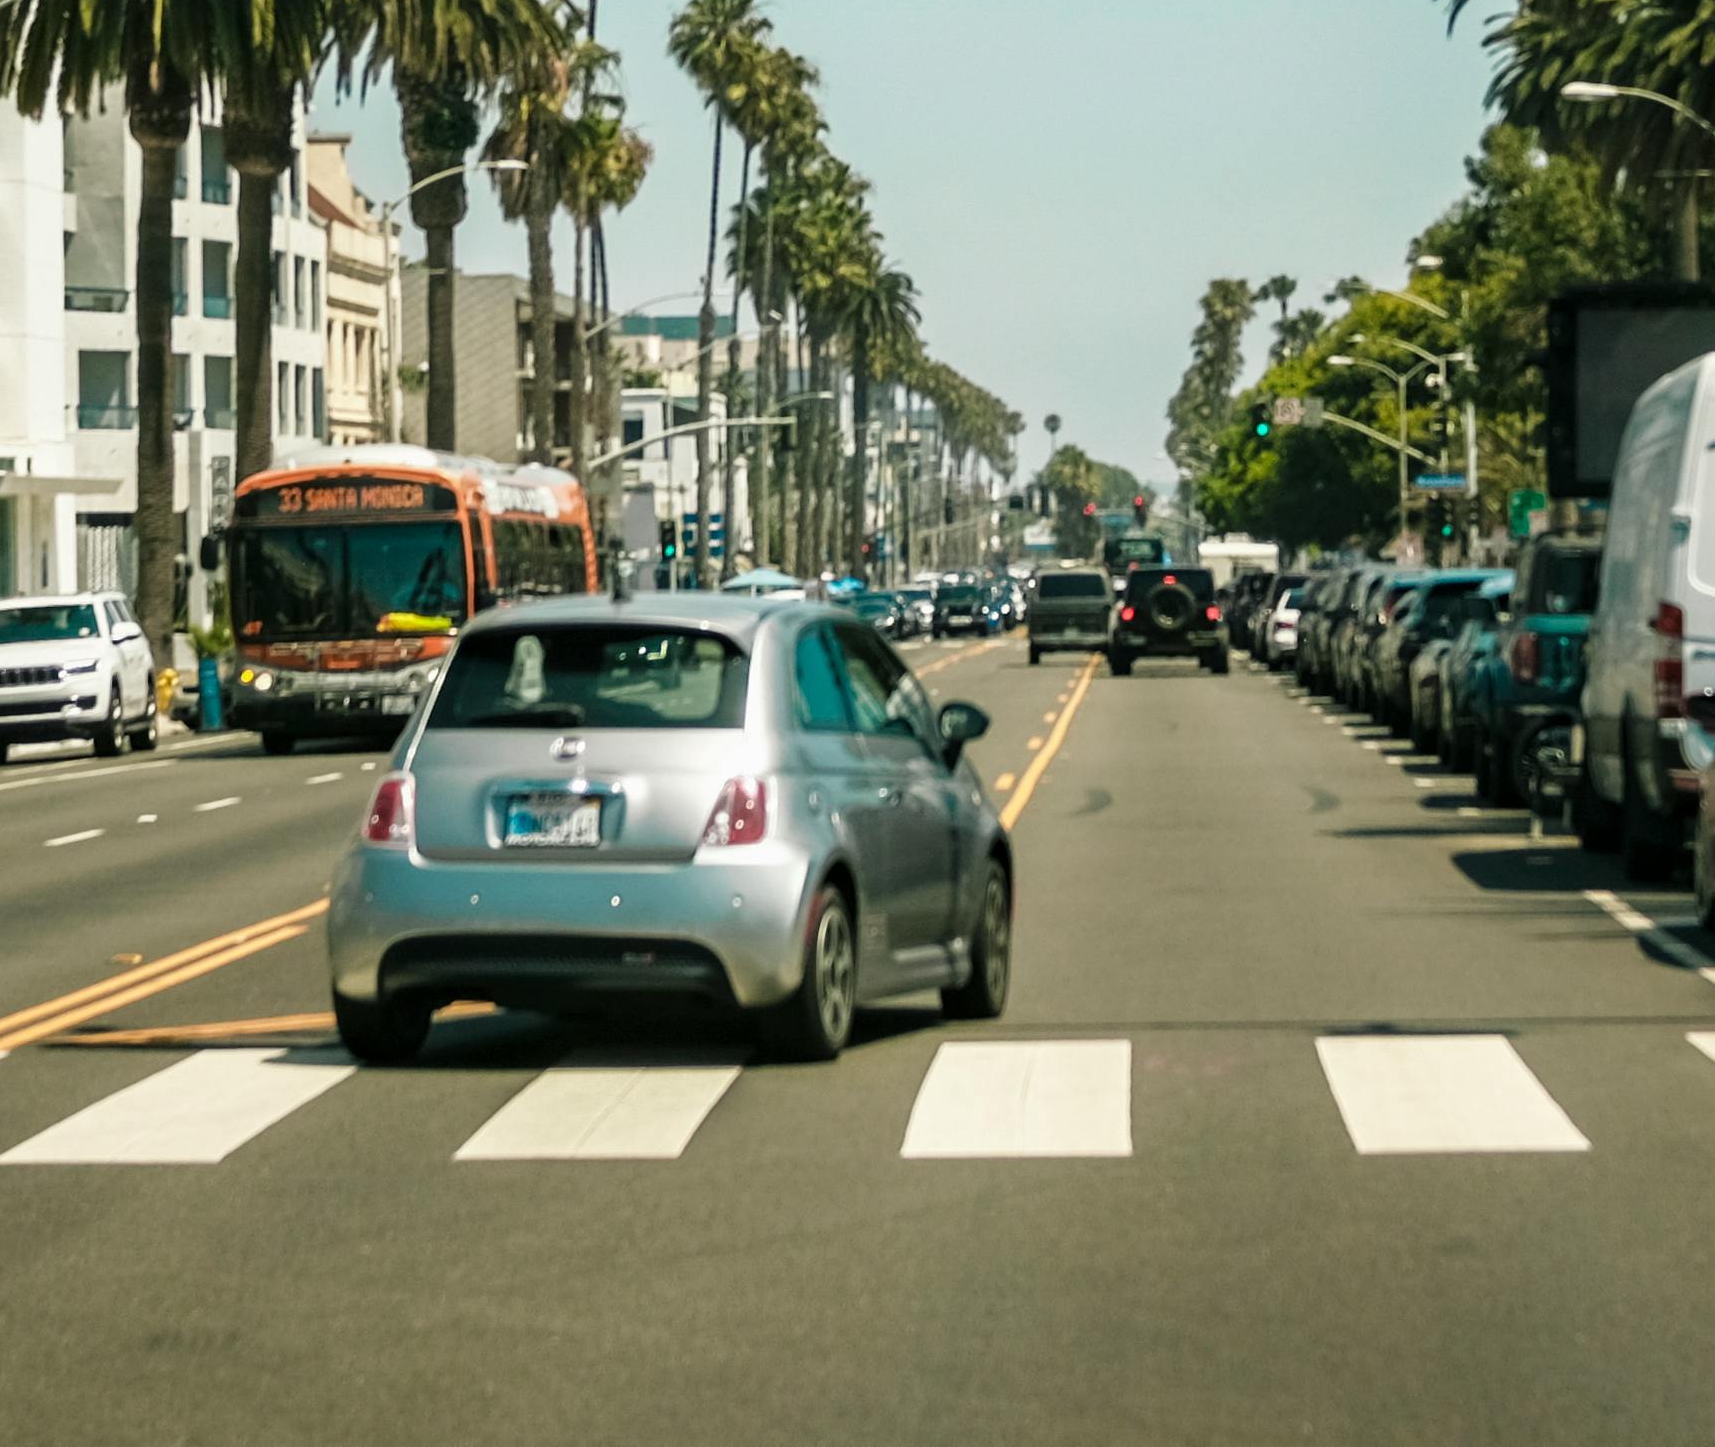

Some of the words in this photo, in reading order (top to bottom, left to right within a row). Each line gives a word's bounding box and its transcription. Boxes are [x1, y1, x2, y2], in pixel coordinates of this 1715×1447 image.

[278, 486, 302, 513] 33
[304, 486, 358, 512] SANTA
[360, 484, 424, 510] MONICA
